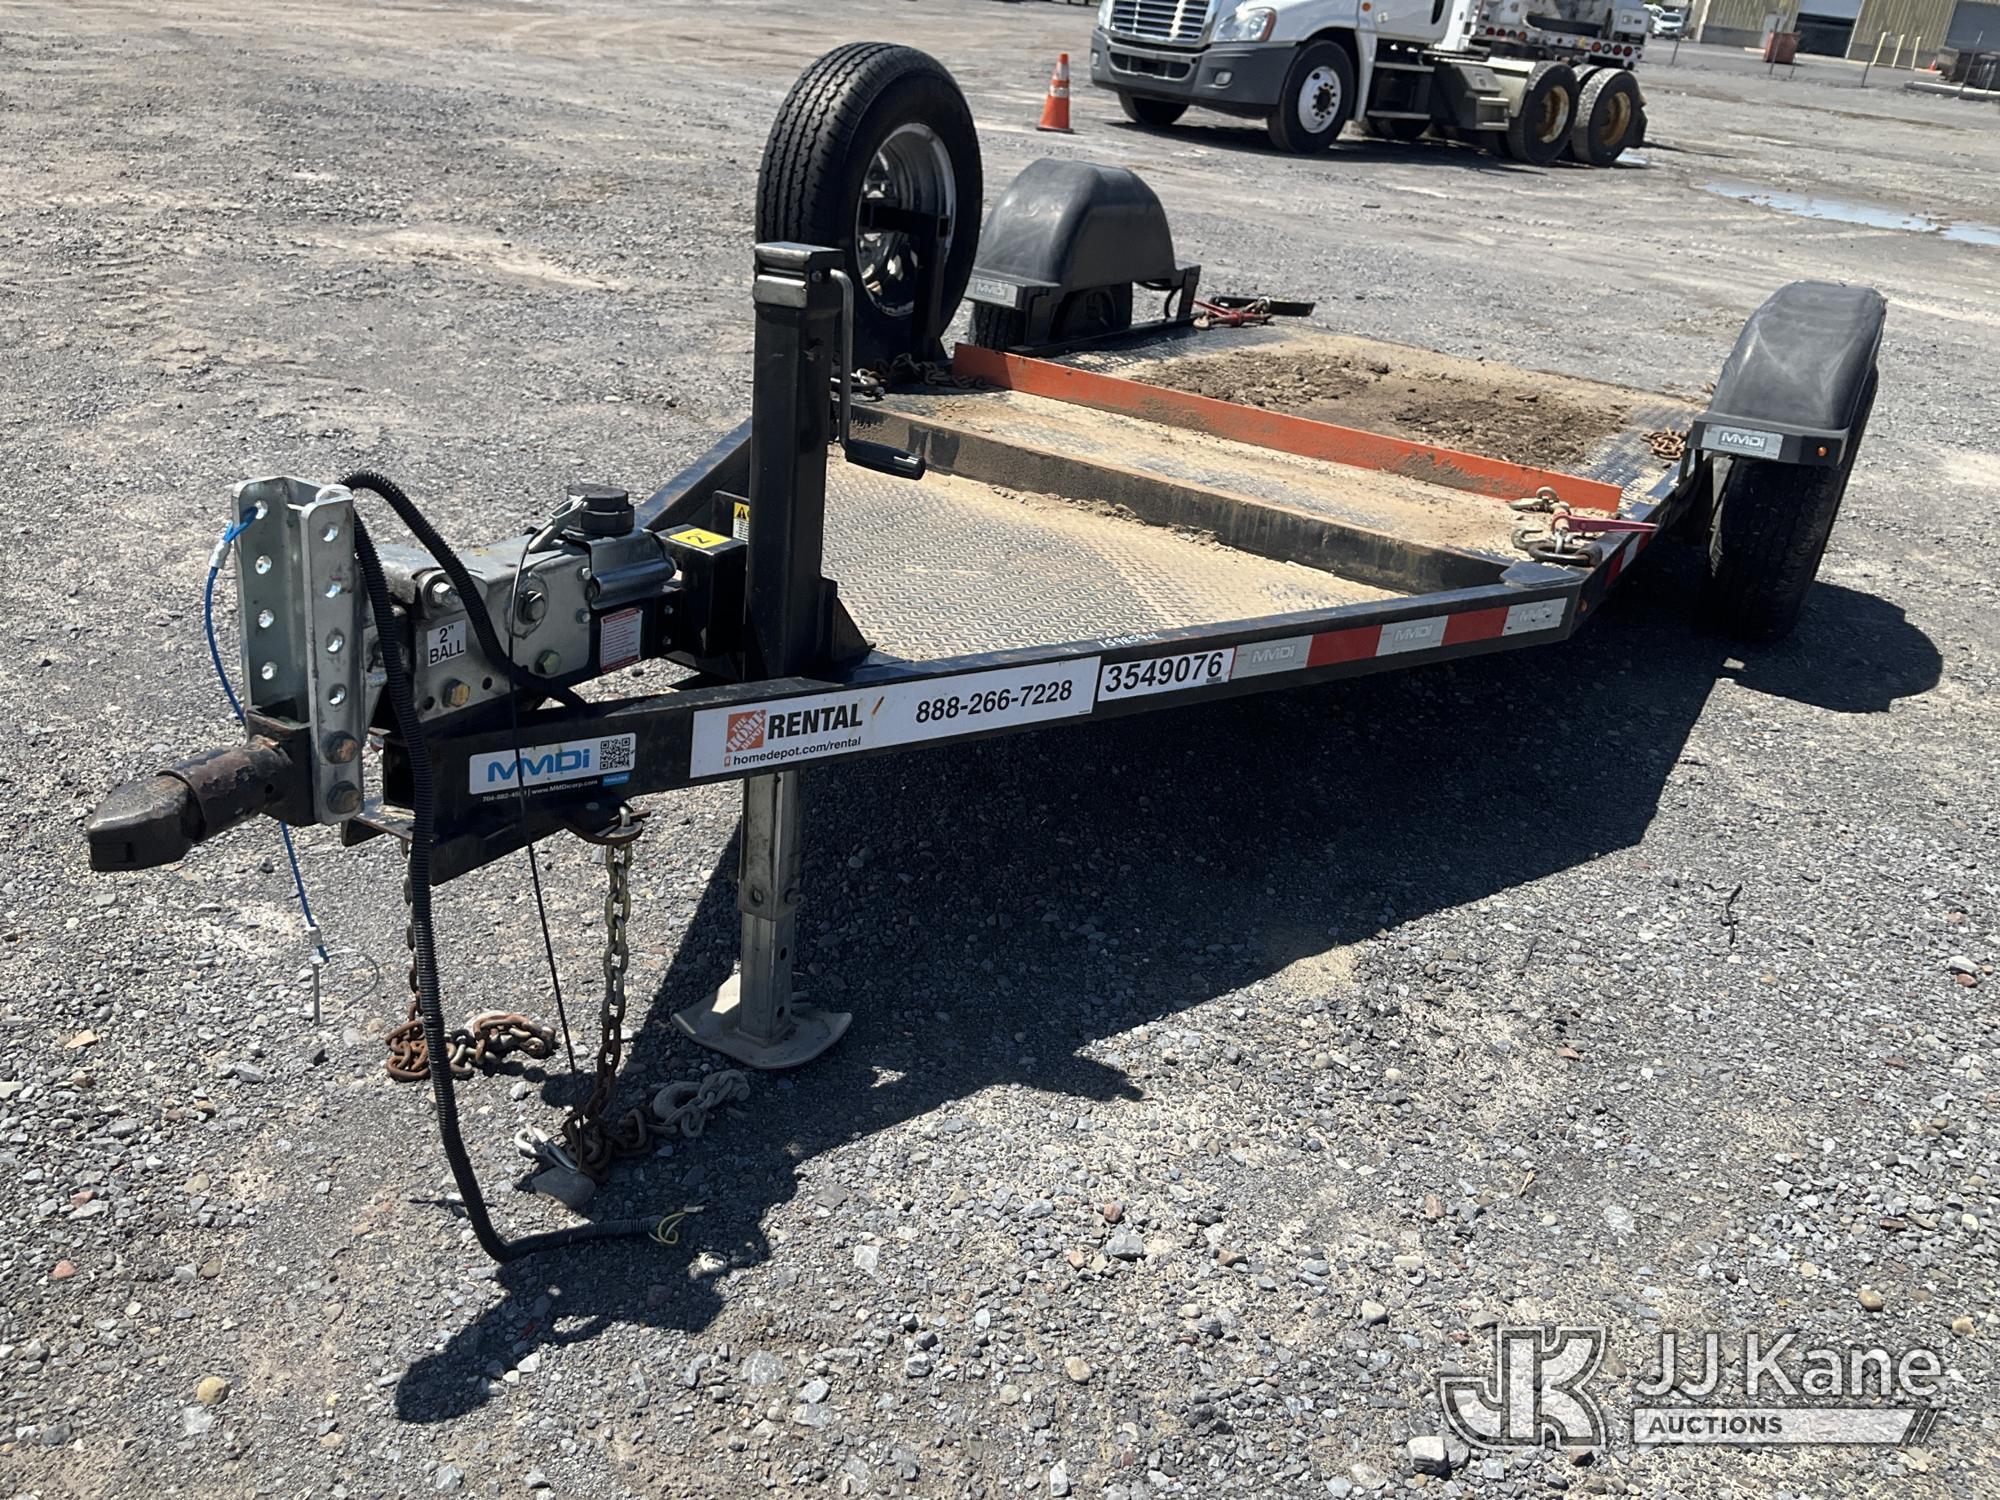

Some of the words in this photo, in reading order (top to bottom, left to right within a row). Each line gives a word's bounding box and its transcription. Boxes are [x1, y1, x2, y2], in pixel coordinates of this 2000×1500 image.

[1721, 432, 1765, 448] MMDi
[440, 624, 454, 644] 2"
[1394, 625, 1433, 641] MMDi
[429, 640, 464, 664] BALL
[1252, 645, 1296, 663] MMDi
[1105, 652, 1223, 693] 3549076
[915, 679, 1073, 724] 888-266-7228
[727, 711, 764, 751] HOME
[768, 703, 863, 740] RENTAL
[487, 748, 590, 783] MMDi
[733, 736, 861, 766] homedepot.com/rental
